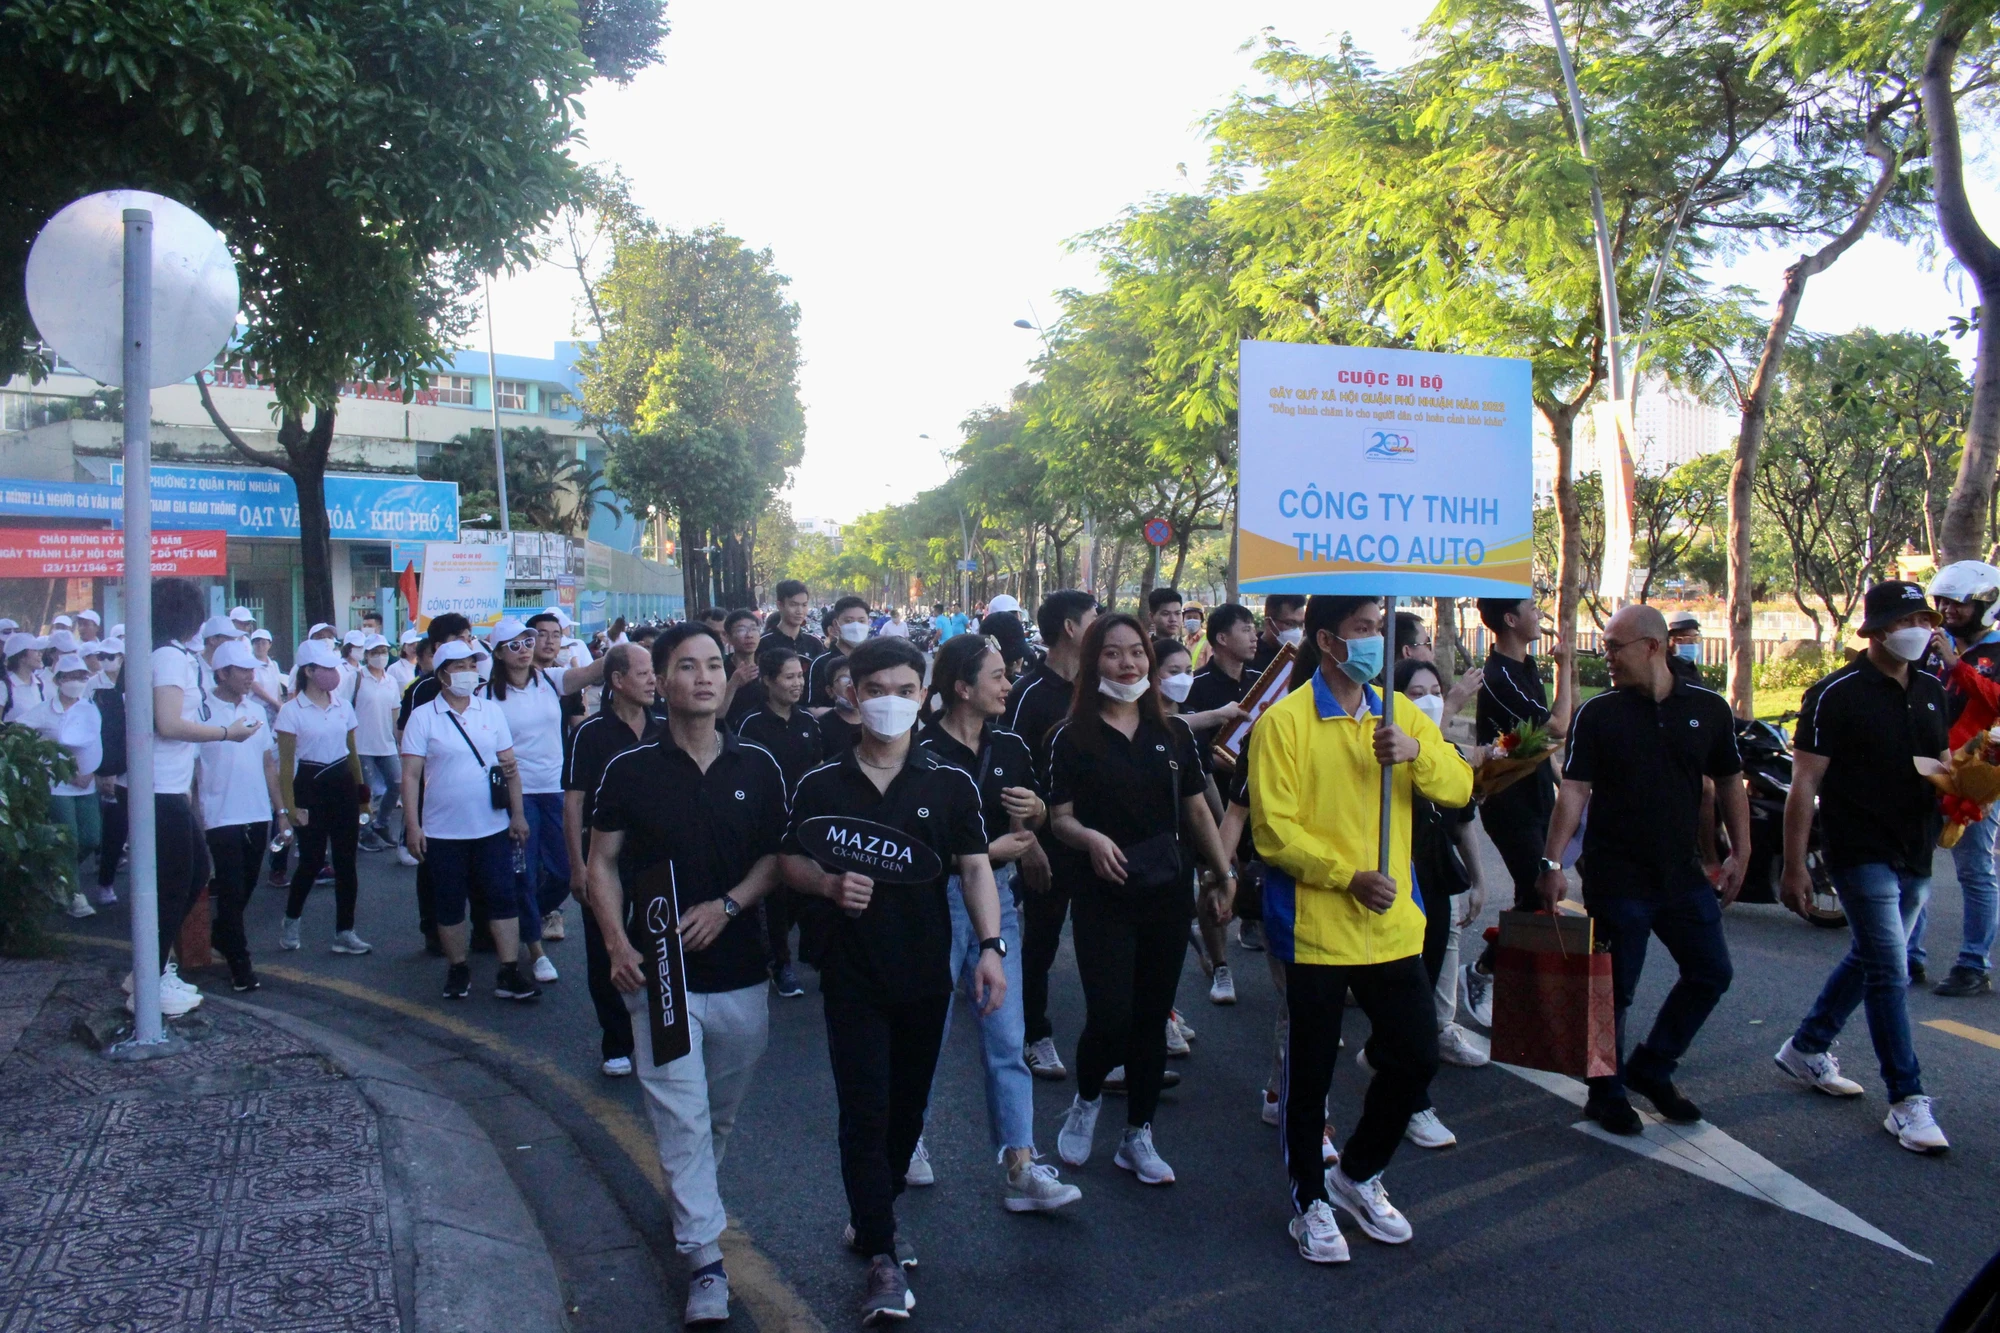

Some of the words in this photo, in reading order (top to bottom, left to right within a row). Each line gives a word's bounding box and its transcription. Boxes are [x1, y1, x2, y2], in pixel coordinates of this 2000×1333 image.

[1337, 369, 1389, 388] CUỘC
[1396, 374, 1414, 387] ĐI
[1420, 374, 1443, 392] BỘ
[1339, 390, 1359, 404] HỘI
[1361, 391, 1392, 406] QUẬN
[1356, 408, 1371, 419] cho
[189, 478, 196, 488] 2
[200, 476, 225, 492] QUẬN
[227, 477, 246, 491] PHÚ
[249, 480, 280, 494] NHUẬN
[111, 494, 124, 510] HÓ
[173, 501, 187, 514] GIA
[189, 501, 208, 515] GIAO
[210, 502, 237, 516] THÔNG
[1278, 482, 1368, 520] CÔNG
[1378, 493, 1415, 522] TY
[1423, 495, 1498, 526] TNHH
[239, 505, 275, 531] OẠT
[279, 504, 301, 528] VĂ
[371, 510, 404, 531] KHU
[409, 504, 440, 532] PHỐ
[444, 514, 454, 533] 4
[39, 533, 67, 545] CHÀO
[1293, 532, 1399, 564] THACO
[1406, 536, 1485, 566] AUTO
[27, 547, 61, 559] THÀNH
[87, 549, 104, 560] HỘI
[174, 548, 194, 559] VIỆT
[196, 550, 217, 558] NAM
[427, 597, 451, 611] CÔNG
[452, 599, 463, 610] TY
[826, 825, 913, 864] MAZDA
[832, 846, 879, 866] CX-NEXT
[881, 859, 904, 873] GEN
